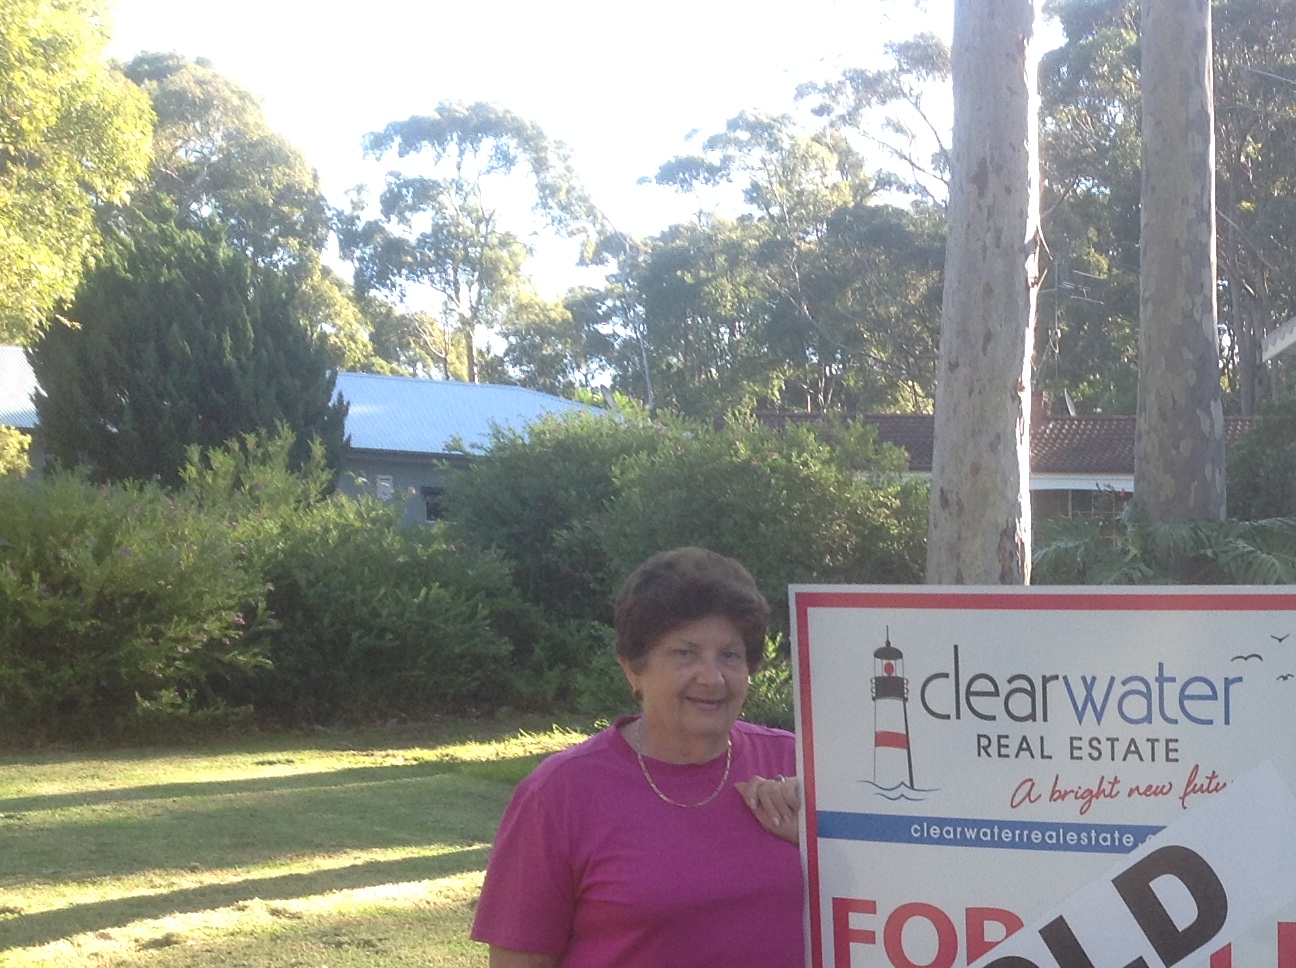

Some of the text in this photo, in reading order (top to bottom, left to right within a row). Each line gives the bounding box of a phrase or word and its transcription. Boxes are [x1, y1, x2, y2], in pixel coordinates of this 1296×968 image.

[920, 644, 1244, 727] clearwater
[976, 733, 1181, 763] REAL ESTATE
[1010, 778, 1042, 809] A
[1049, 774, 1121, 815] bright
[1127, 781, 1173, 798] new
